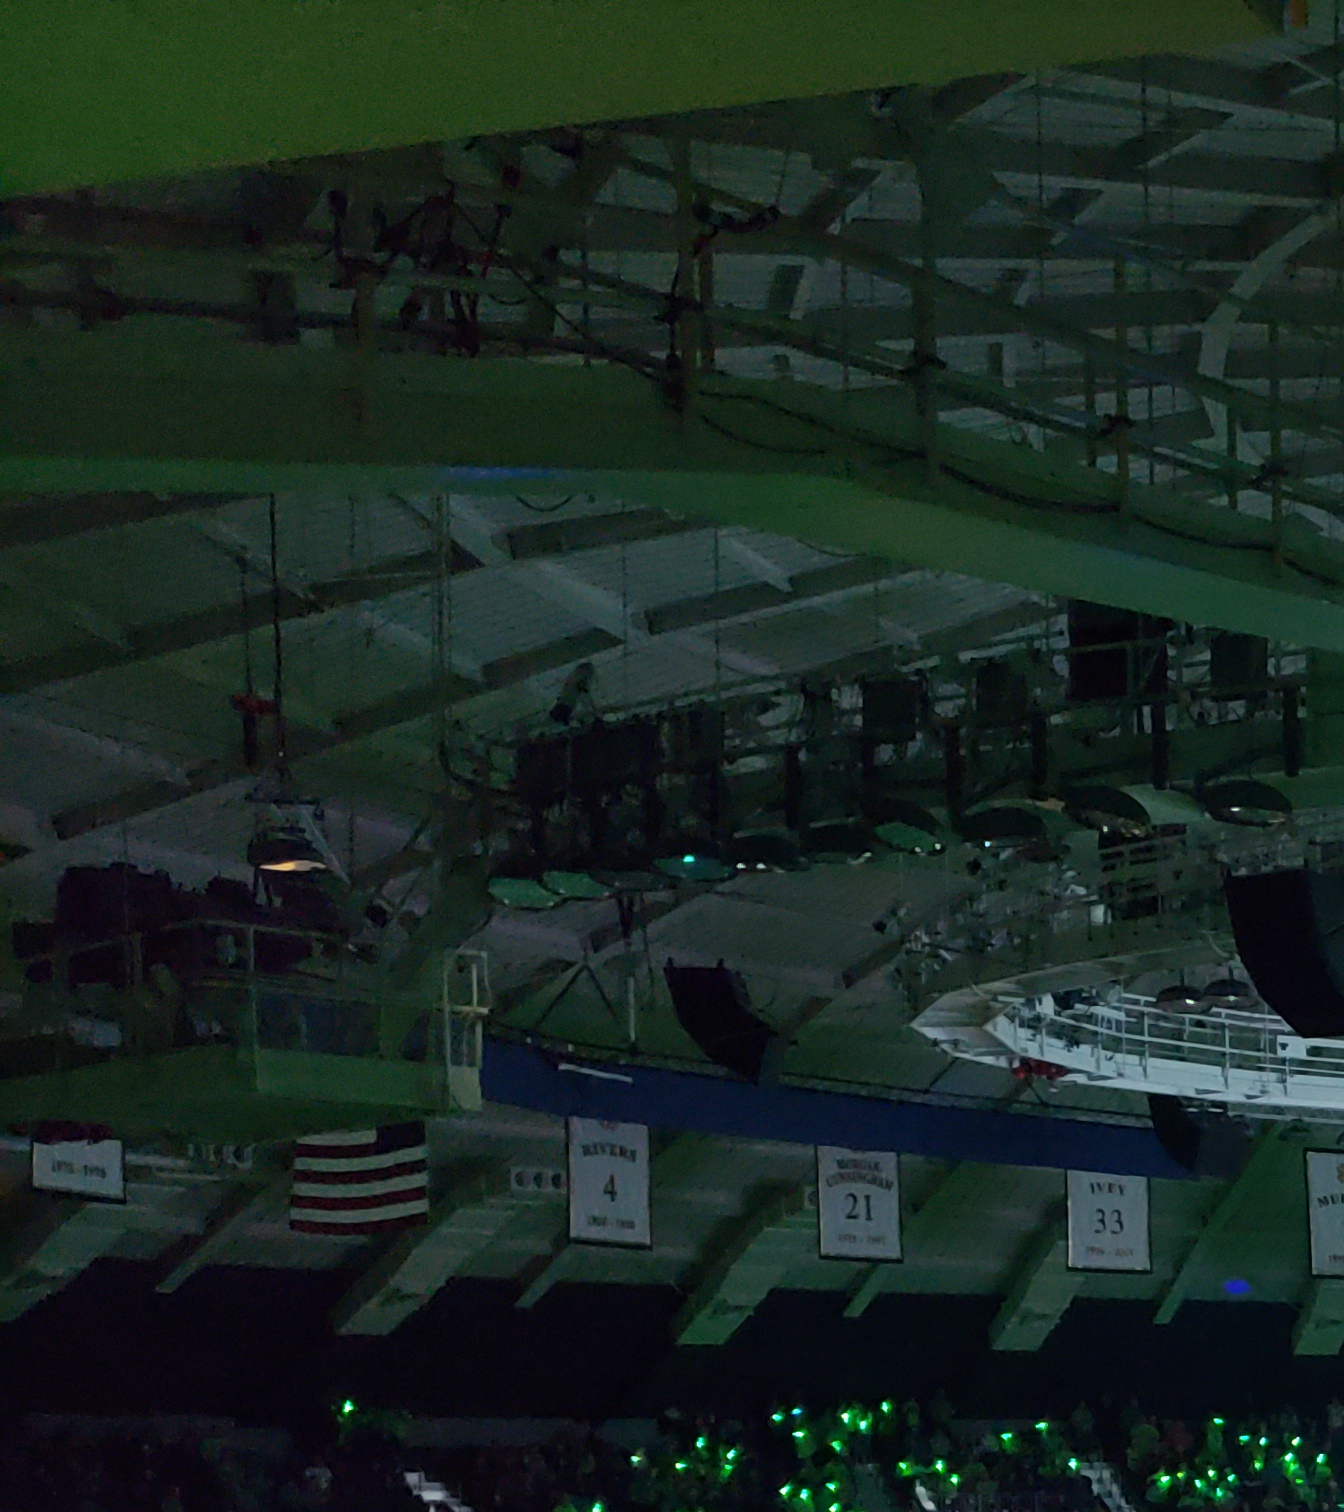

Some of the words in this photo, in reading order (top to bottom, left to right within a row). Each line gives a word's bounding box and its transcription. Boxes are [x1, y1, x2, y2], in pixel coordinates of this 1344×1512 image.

[581, 1143, 637, 1163] RIVERS
[603, 1173, 618, 1203] 4
[1089, 1182, 1126, 1197] IVEY
[845, 1192, 874, 1222] 21
[1094, 1208, 1125, 1235] 33
